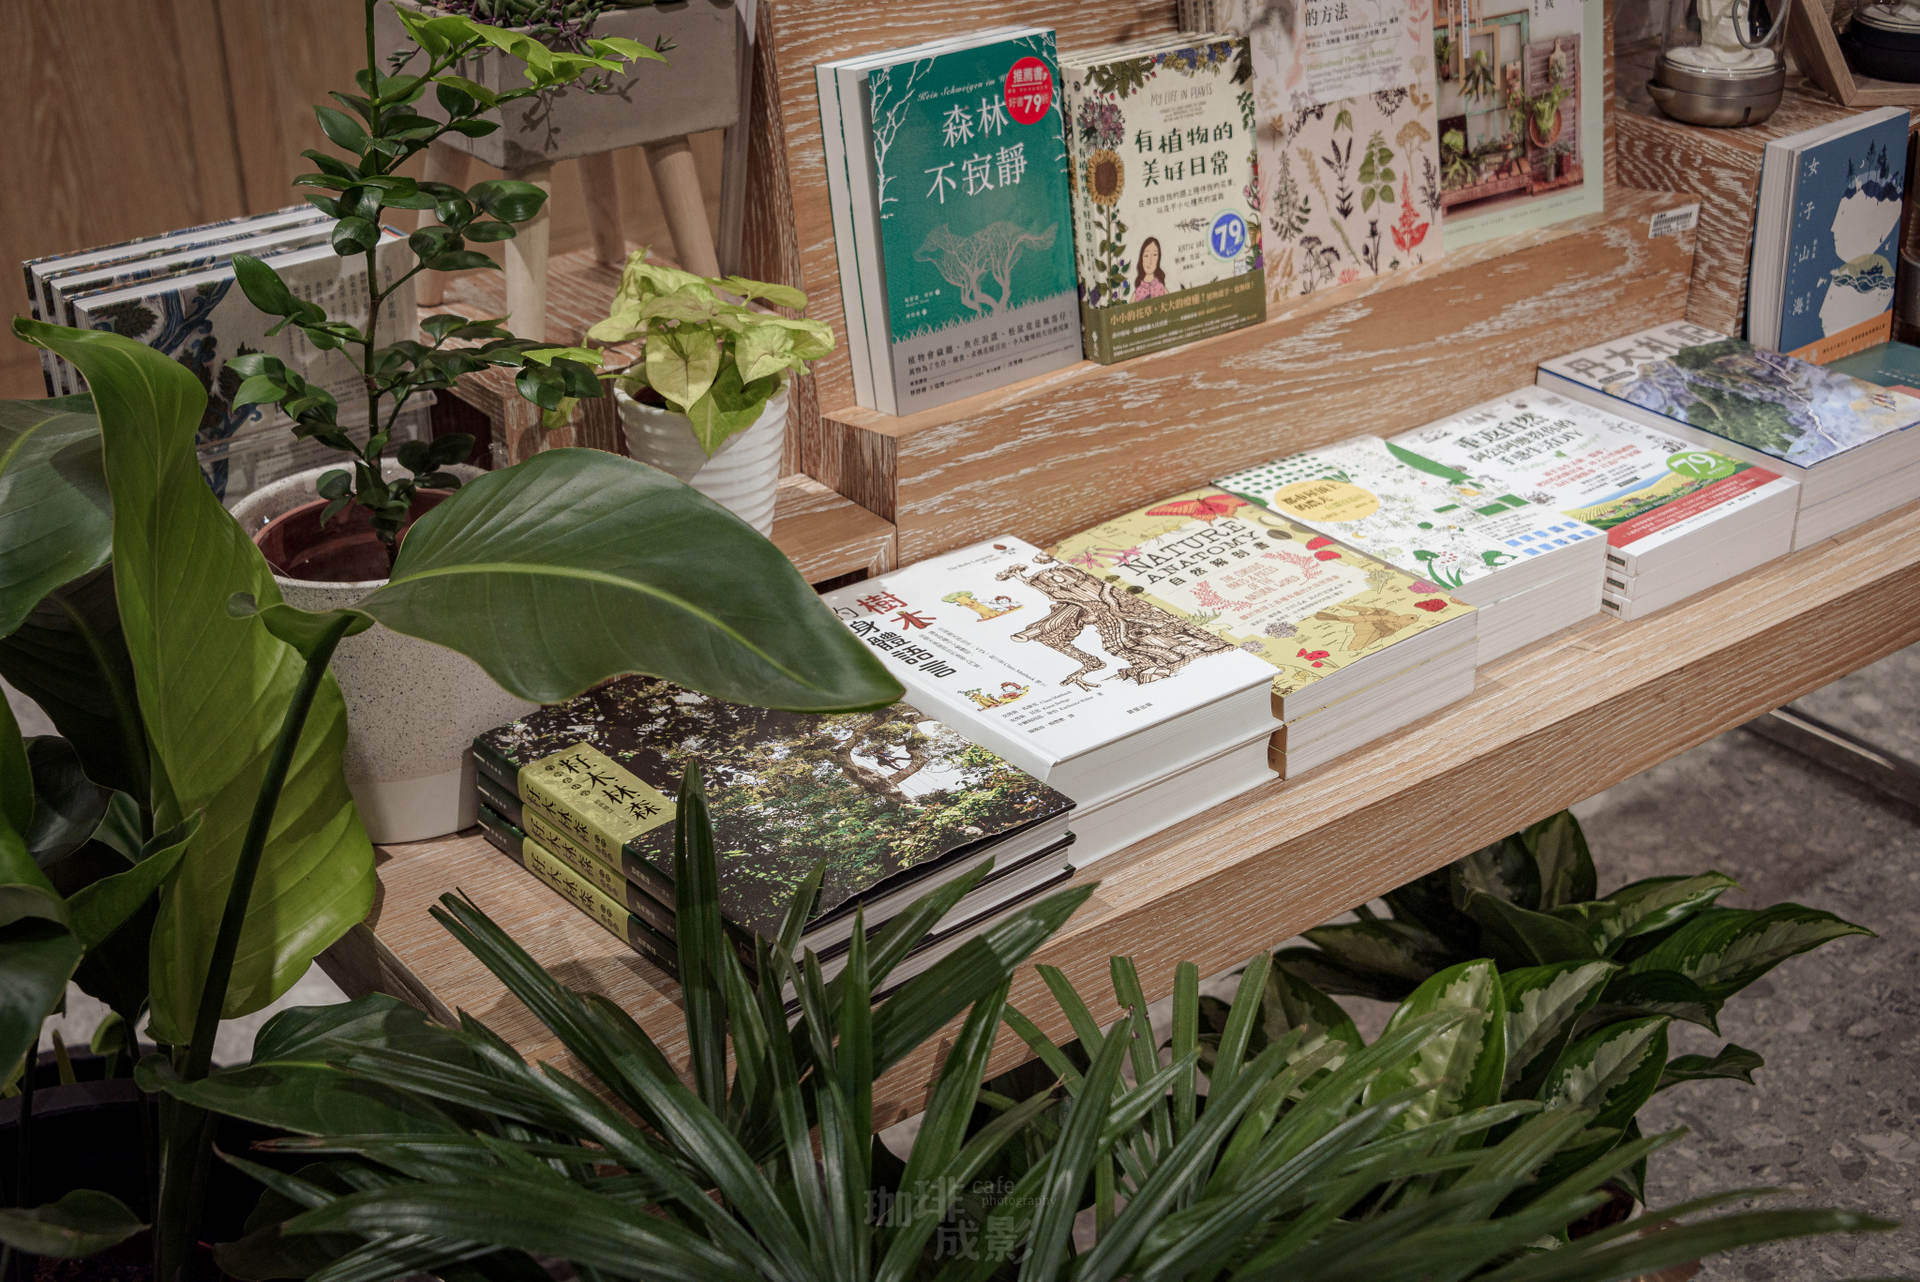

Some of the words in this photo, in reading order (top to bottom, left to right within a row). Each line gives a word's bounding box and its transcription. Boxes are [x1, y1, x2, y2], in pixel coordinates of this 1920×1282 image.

[1305, 2, 1348, 28] 的方法
[942, 94, 1009, 149] 森林
[1134, 121, 1234, 155] 有植物的
[924, 142, 1028, 205] 不寂靜
[1141, 150, 1229, 188] 美好日常
[1214, 219, 1243, 252] 79
[1670, 453, 1717, 475] 79
[1118, 520, 1248, 577] NATURE
[1144, 530, 1262, 586] ANATOMY
[1169, 541, 1271, 587] 自然解剖書
[856, 591, 937, 631] 樹木
